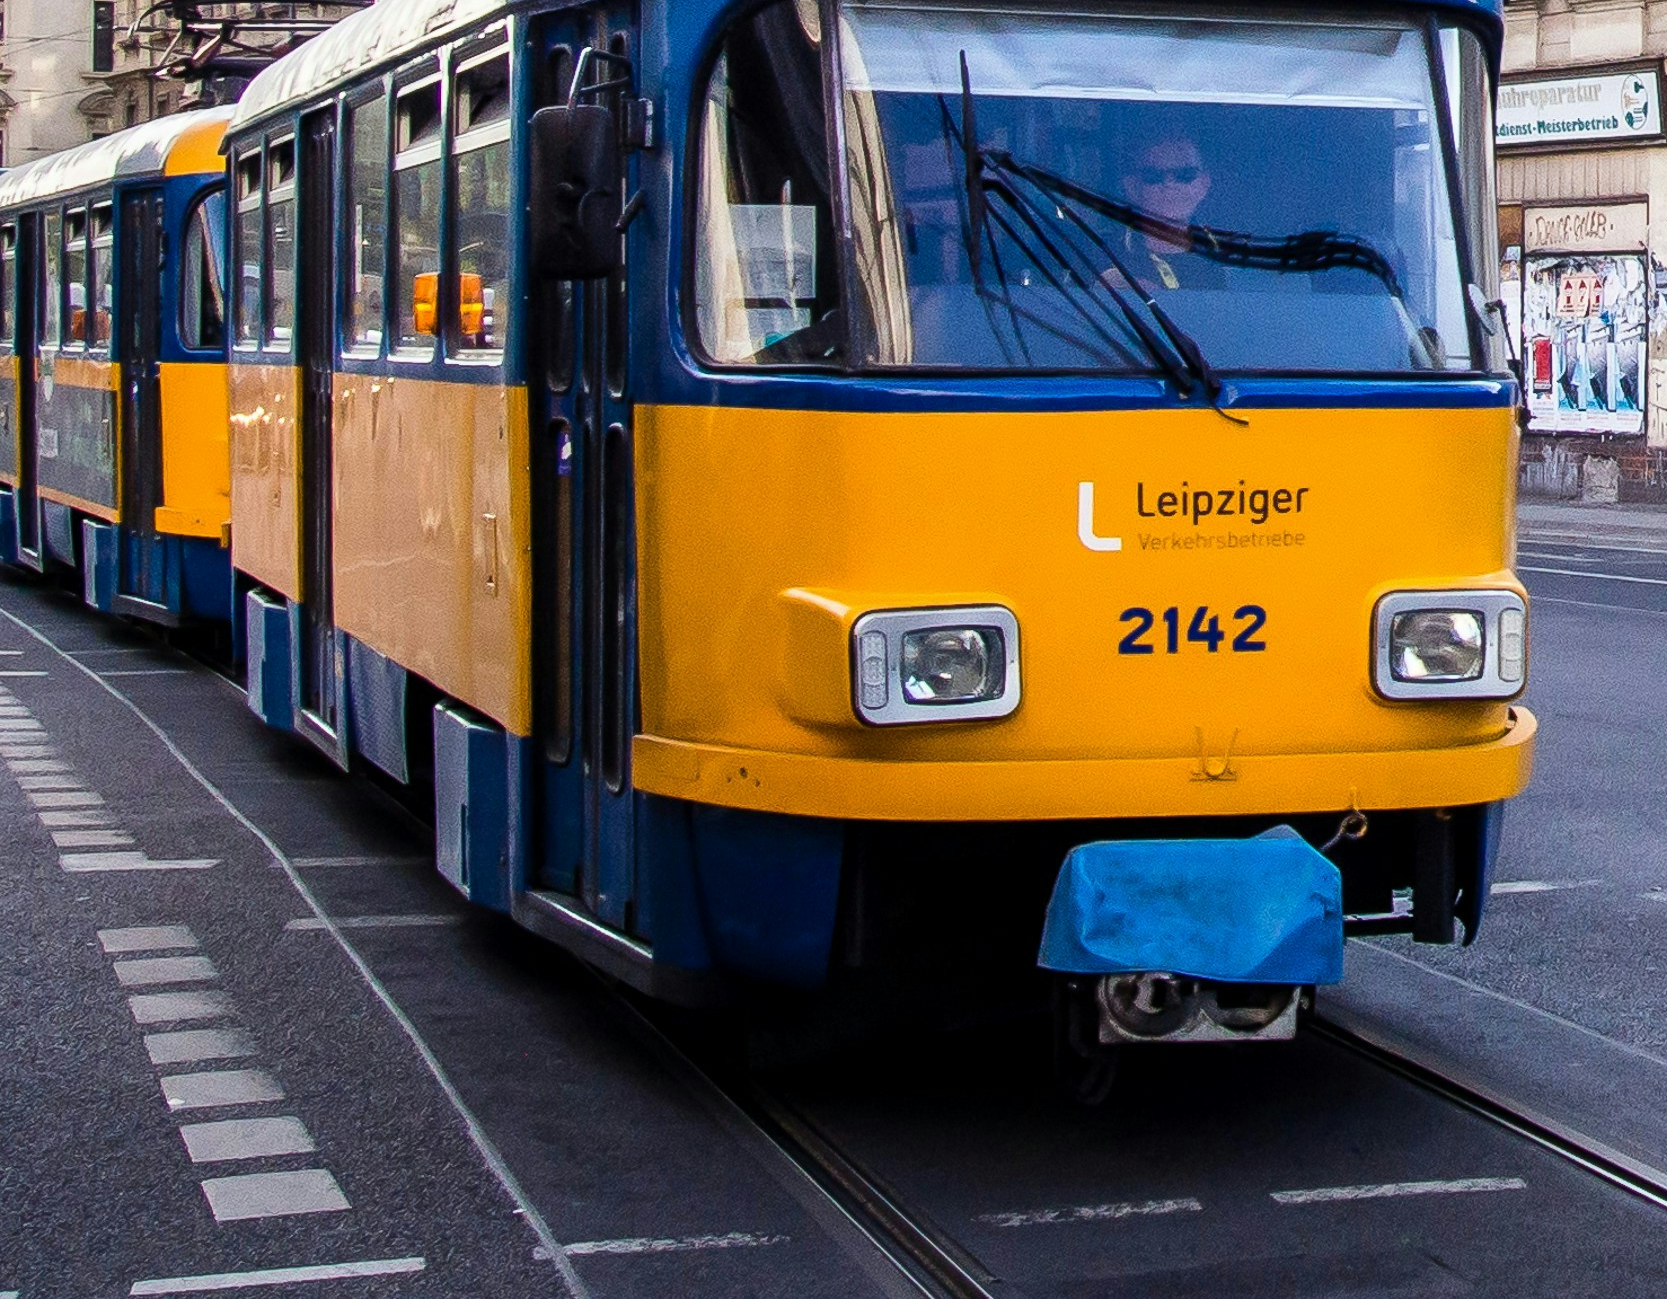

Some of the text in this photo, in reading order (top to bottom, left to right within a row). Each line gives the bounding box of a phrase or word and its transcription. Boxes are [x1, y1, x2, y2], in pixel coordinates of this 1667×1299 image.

[1136, 479, 1310, 526] Leipziger
[1137, 531, 1307, 551] Verkehrsbetriebe
[1117, 604, 1268, 656] 2142
